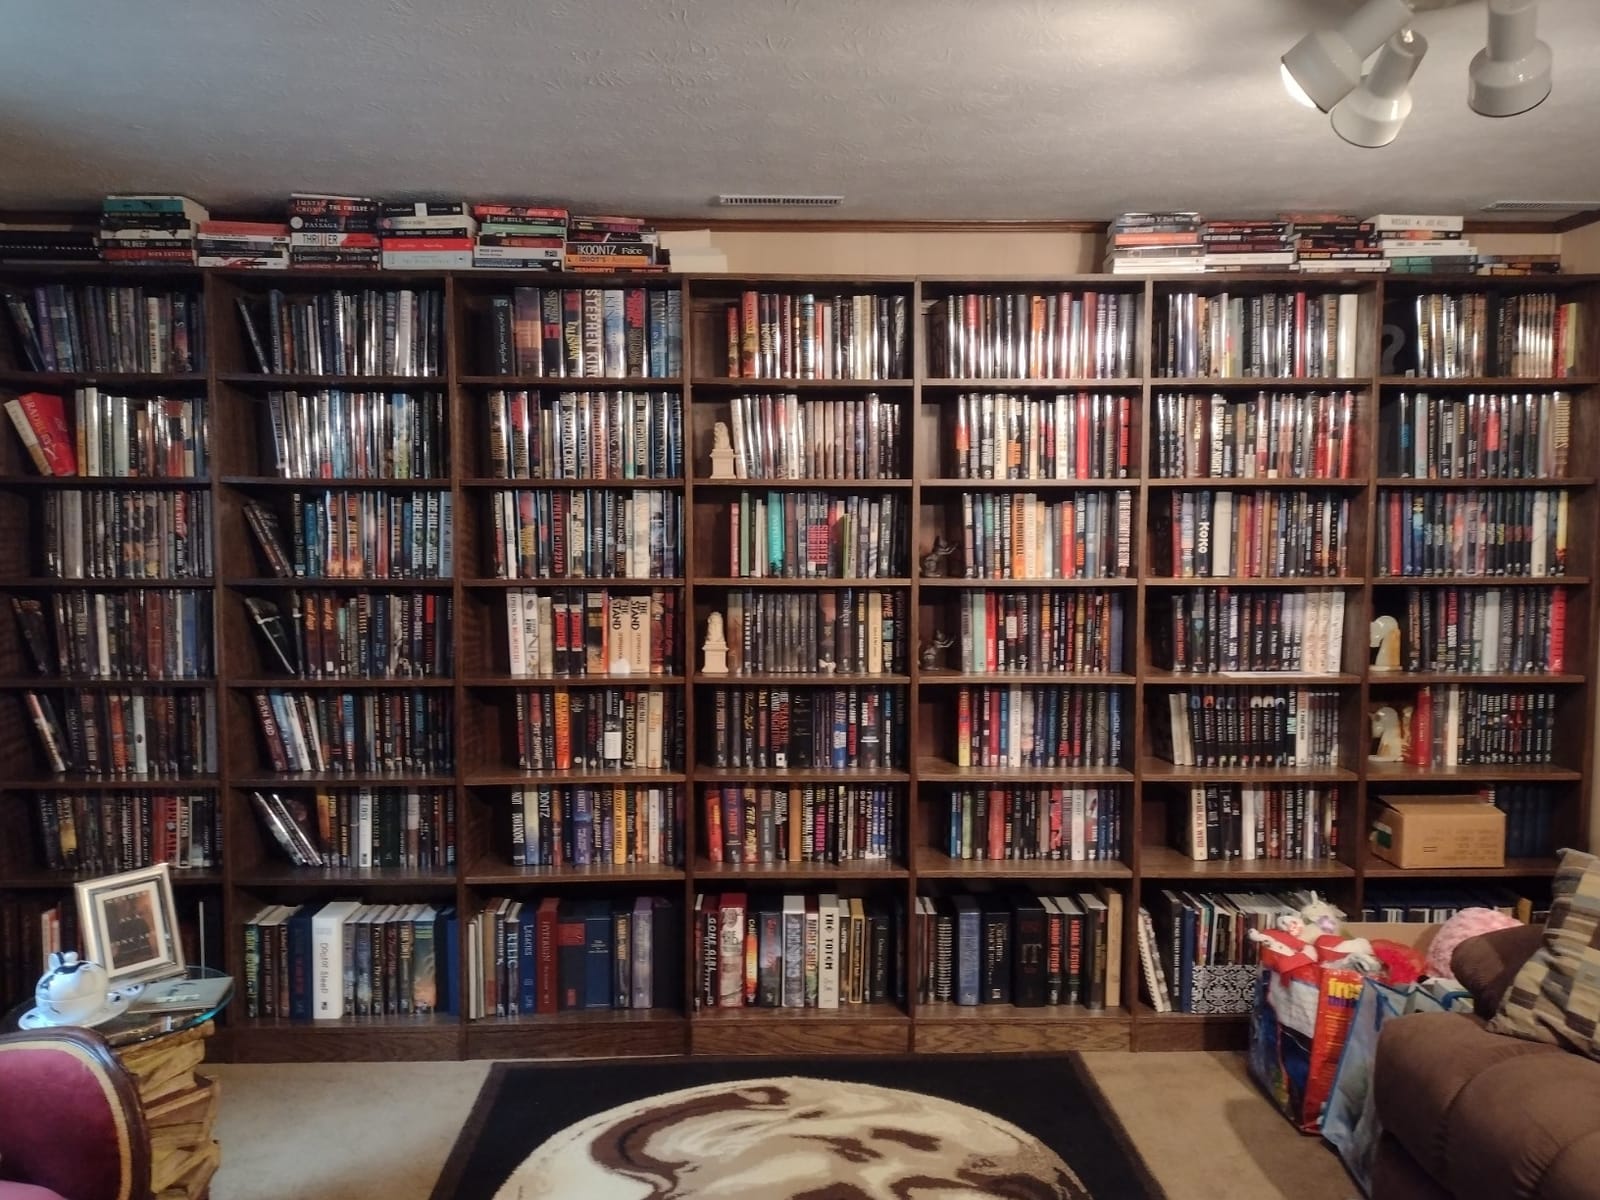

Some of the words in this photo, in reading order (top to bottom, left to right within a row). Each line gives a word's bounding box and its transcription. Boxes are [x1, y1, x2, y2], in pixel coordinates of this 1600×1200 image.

[580, 244, 617, 256] KOONTZ
[584, 289, 599, 347] STEPHEN
[565, 320, 580, 360] TALISMAN
[1212, 406, 1224, 440] SUMMER
[1554, 400, 1570, 448] WARRIORS
[1212, 440, 1224, 450] OF
[563, 448, 574, 470] CREW
[1212, 451, 1224, 474] NIGHT
[412, 498, 423, 512] JOE
[427, 498, 438, 512] JOE
[1016, 498, 1024, 522] DAVID
[1119, 500, 1130, 510] THE
[412, 513, 423, 529] HILL
[427, 513, 438, 529] HILL
[1016, 522, 1024, 556] MORRELL
[1198, 522, 1210, 554] KOKO
[612, 600, 622, 630] STAND
[631, 600, 640, 630] STAND
[640, 600, 648, 614] THE
[882, 594, 894, 618] MINE
[256, 695, 271, 717] BORN
[626, 705, 634, 720] THE
[780, 702, 789, 728] SPEAKS
[263, 720, 275, 736] BAD
[626, 720, 634, 739] DEAD
[626, 739, 634, 760] ZONE
[806, 834, 814, 852] SMITH
[816, 814, 825, 851] INTRUDERS
[708, 917, 718, 940] GONE
[825, 914, 834, 934] THE
[507, 932, 518, 969] RELIC
[542, 921, 550, 963] HYPERION
[708, 944, 718, 972] GIRL
[825, 938, 834, 970] TOTEM
